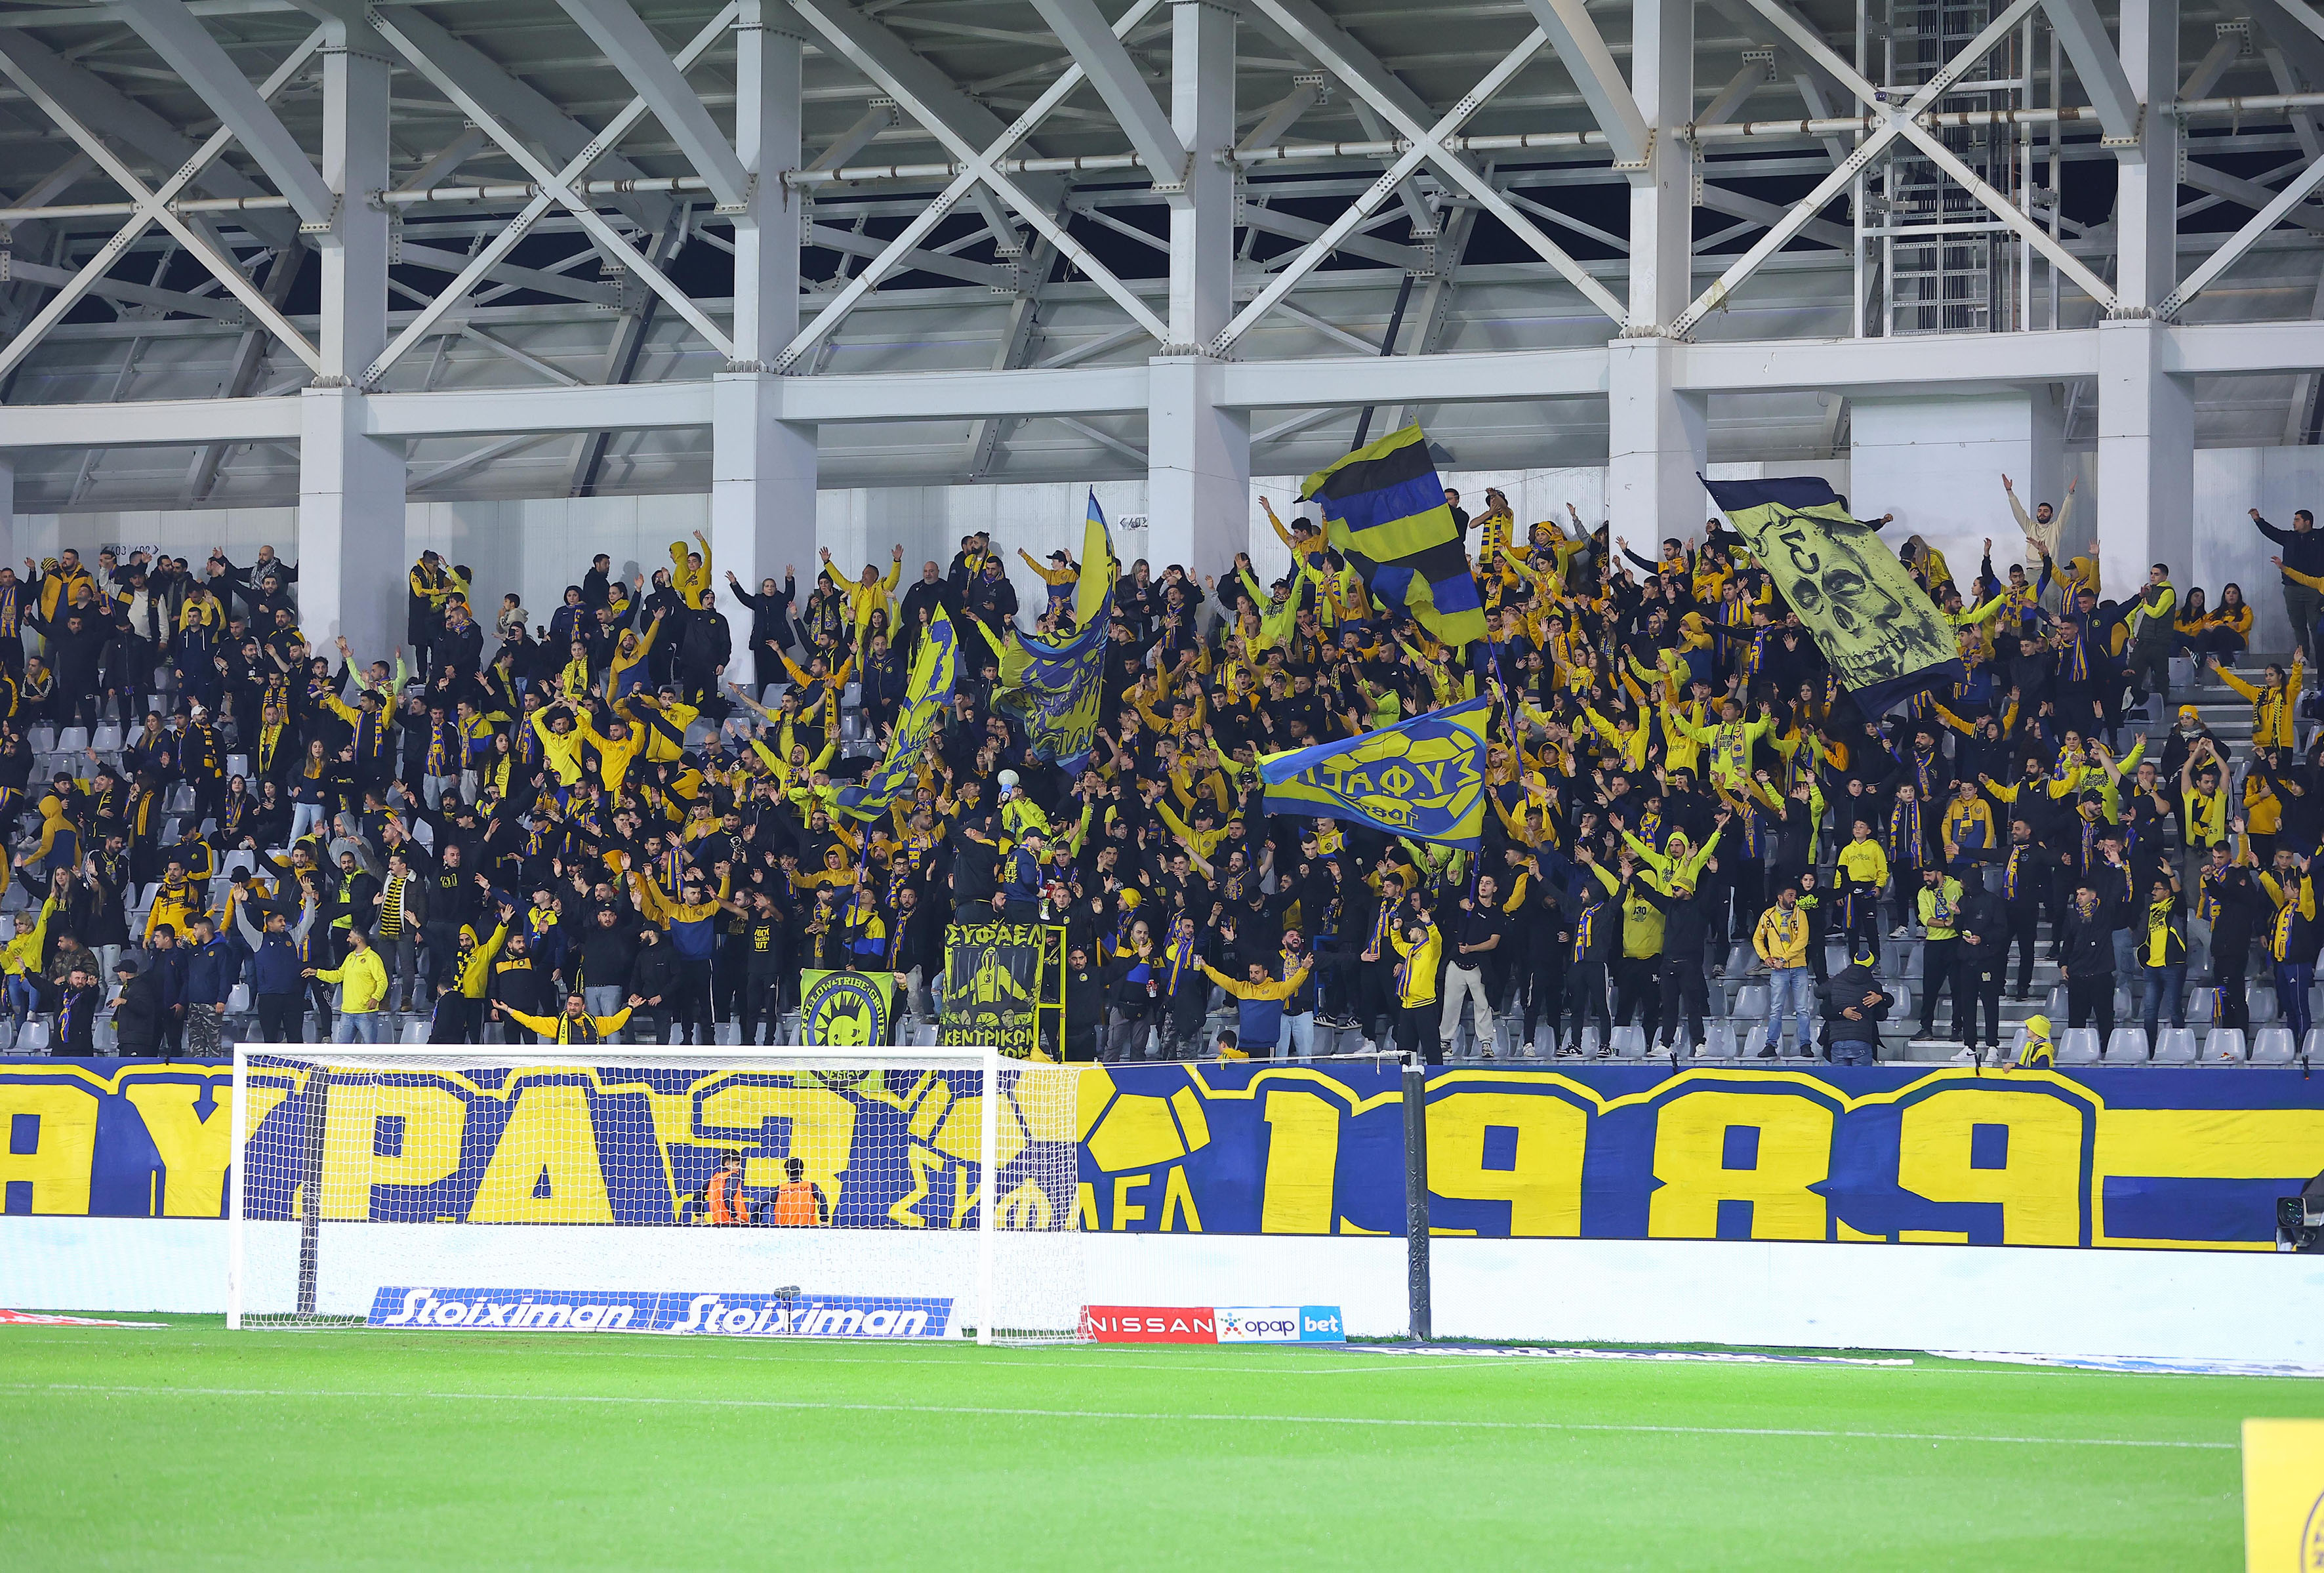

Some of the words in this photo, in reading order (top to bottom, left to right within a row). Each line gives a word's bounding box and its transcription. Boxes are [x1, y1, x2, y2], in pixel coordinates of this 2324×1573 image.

[111, 546, 127, 556] 03
[1779, 529, 1820, 575] 3
[985, 974, 991, 983] 3
[801, 980, 833, 1030] YELLOW
[836, 976, 869, 992] TRIBE
[868, 988, 885, 1036] GROUP
[1261, 1088, 2083, 1247] 1989
[383, 1288, 635, 1328] Stoiximan
[673, 1294, 929, 1336] Stoiximan
[1087, 1317, 1213, 1334] NISSAN
[1245, 1320, 1295, 1336] opap
[1304, 1314, 1339, 1334] bet
